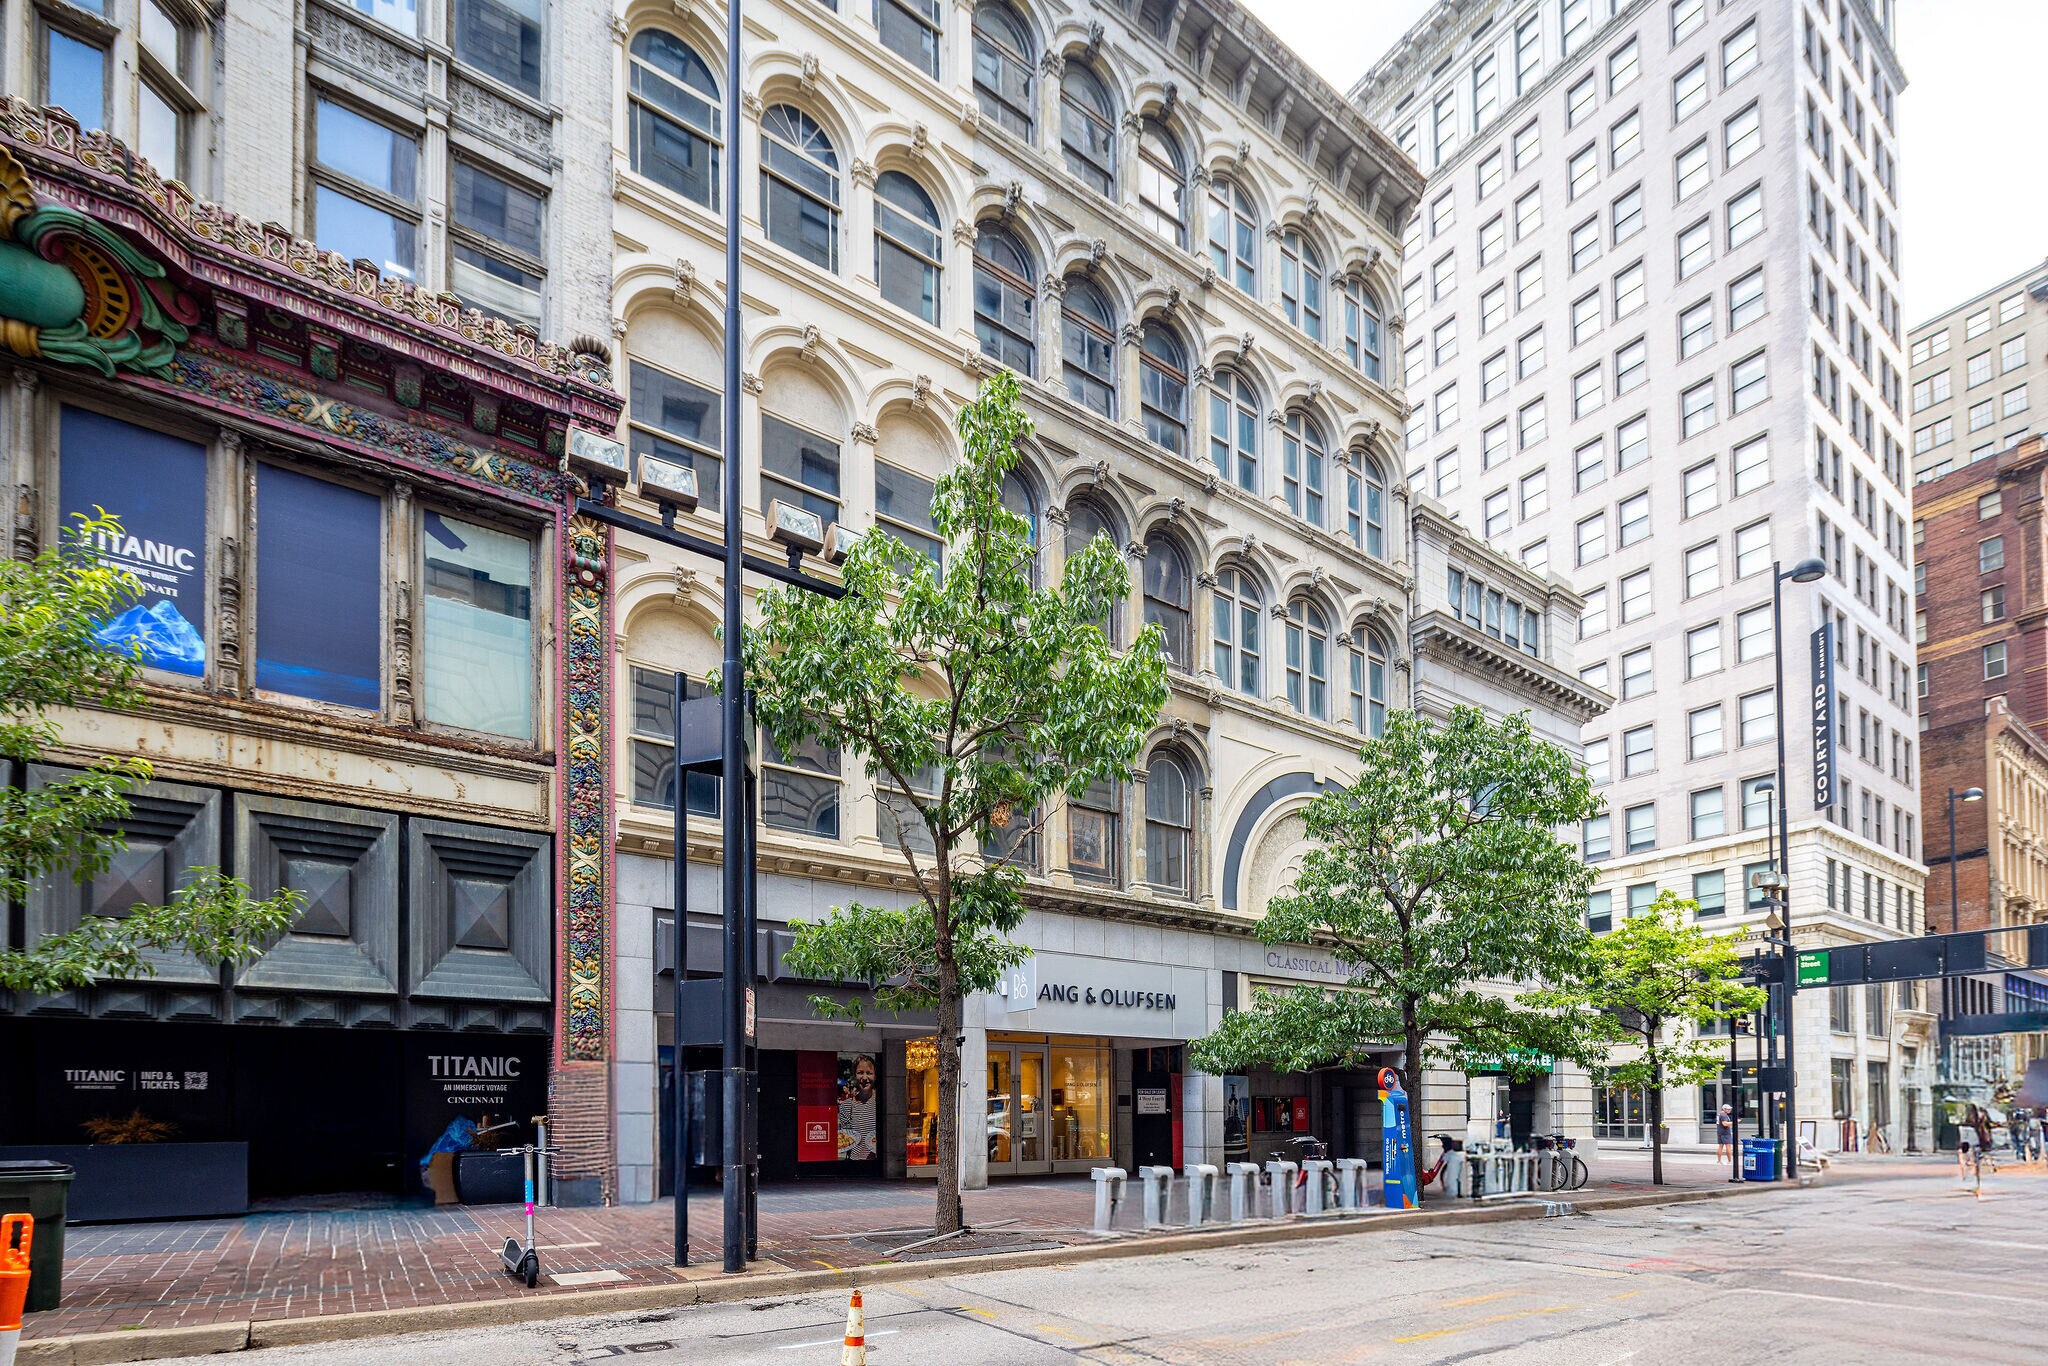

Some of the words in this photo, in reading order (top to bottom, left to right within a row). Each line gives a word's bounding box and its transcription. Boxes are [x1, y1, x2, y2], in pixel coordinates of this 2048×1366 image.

[1815, 683, 1828, 804] COURTYARD
[1037, 983, 1079, 1003] ANG
[1085, 987, 1097, 1004] &
[1101, 988, 1176, 1010] OLUFSEN
[428, 1055, 521, 1077] TITANIC
[64, 1069, 126, 1081] TITANIC
[141, 1071, 163, 1080] INFO
[166, 1071, 173, 1080] &
[141, 1081, 180, 1090] TICKETS
[447, 1096, 504, 1104] CINCINNATI
